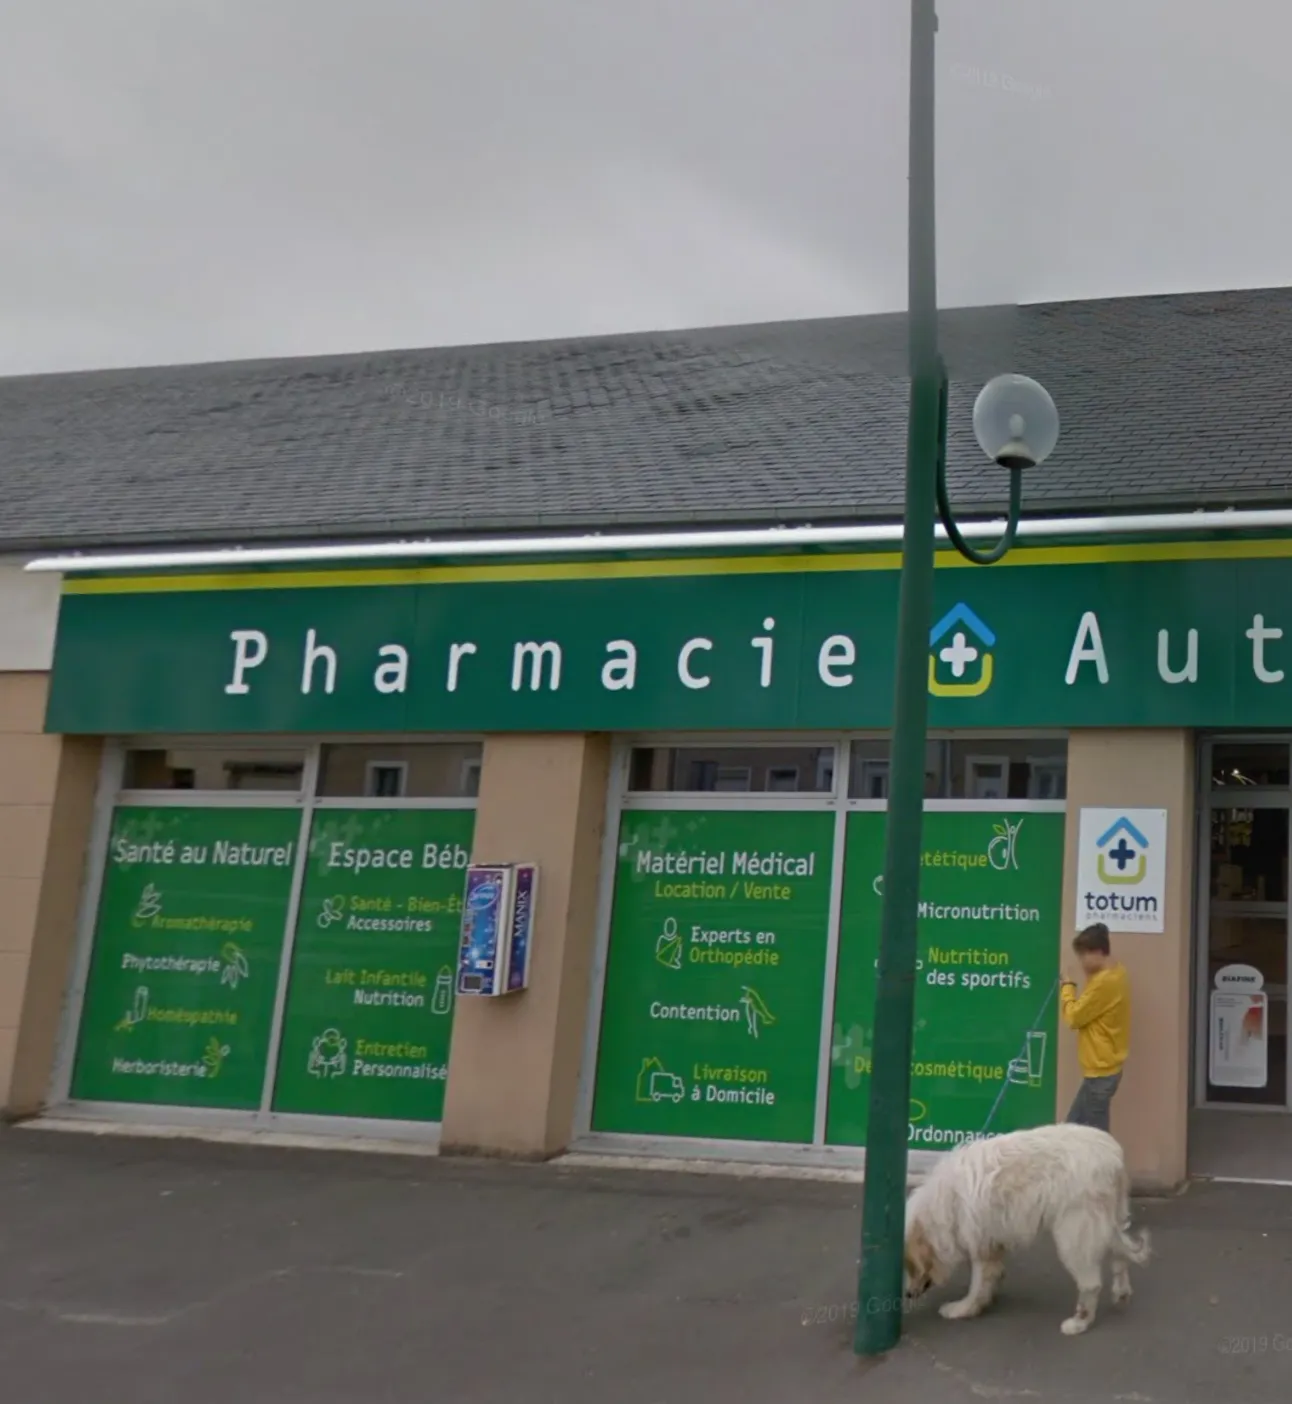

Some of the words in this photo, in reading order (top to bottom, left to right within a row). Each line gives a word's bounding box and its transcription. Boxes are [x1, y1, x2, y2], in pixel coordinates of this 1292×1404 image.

[223, 617, 857, 695] Pharmacie
[113, 839, 175, 864] Santé
[180, 846, 207, 864] au
[213, 841, 292, 866] Naturel
[328, 842, 413, 874] Espace
[422, 844, 468, 869] Béb
[636, 850, 725, 874] Matériel
[732, 851, 815, 876] Médical
[655, 880, 725, 898] Location
[744, 882, 792, 900] Vente
[350, 895, 391, 912] Santé
[917, 901, 1040, 921] Micronutrition
[1084, 892, 1157, 911] totum
[347, 915, 432, 932] Accessoires
[514, 890, 528, 937] MANIX
[151, 915, 253, 933] Aromathérapie
[691, 926, 751, 947] Experts
[756, 931, 775, 944] en
[121, 953, 221, 974] Phytothérapie
[689, 947, 780, 967] Orthopédie
[928, 948, 1009, 965] Nutrition
[325, 969, 355, 985] Lait
[360, 970, 427, 986] Infantile
[926, 969, 955, 985] des
[961, 970, 1031, 991] sportifs
[354, 989, 424, 1007] Nutrition
[147, 1006, 238, 1026] Homéopathie
[650, 1002, 740, 1021] Contention
[356, 1040, 427, 1058] Entretien
[113, 1057, 207, 1077] Herboristerie
[352, 1059, 448, 1080] Personnalisé
[693, 1064, 767, 1083] Livraison
[691, 1086, 701, 1101] à
[706, 1085, 775, 1105] Domicile
